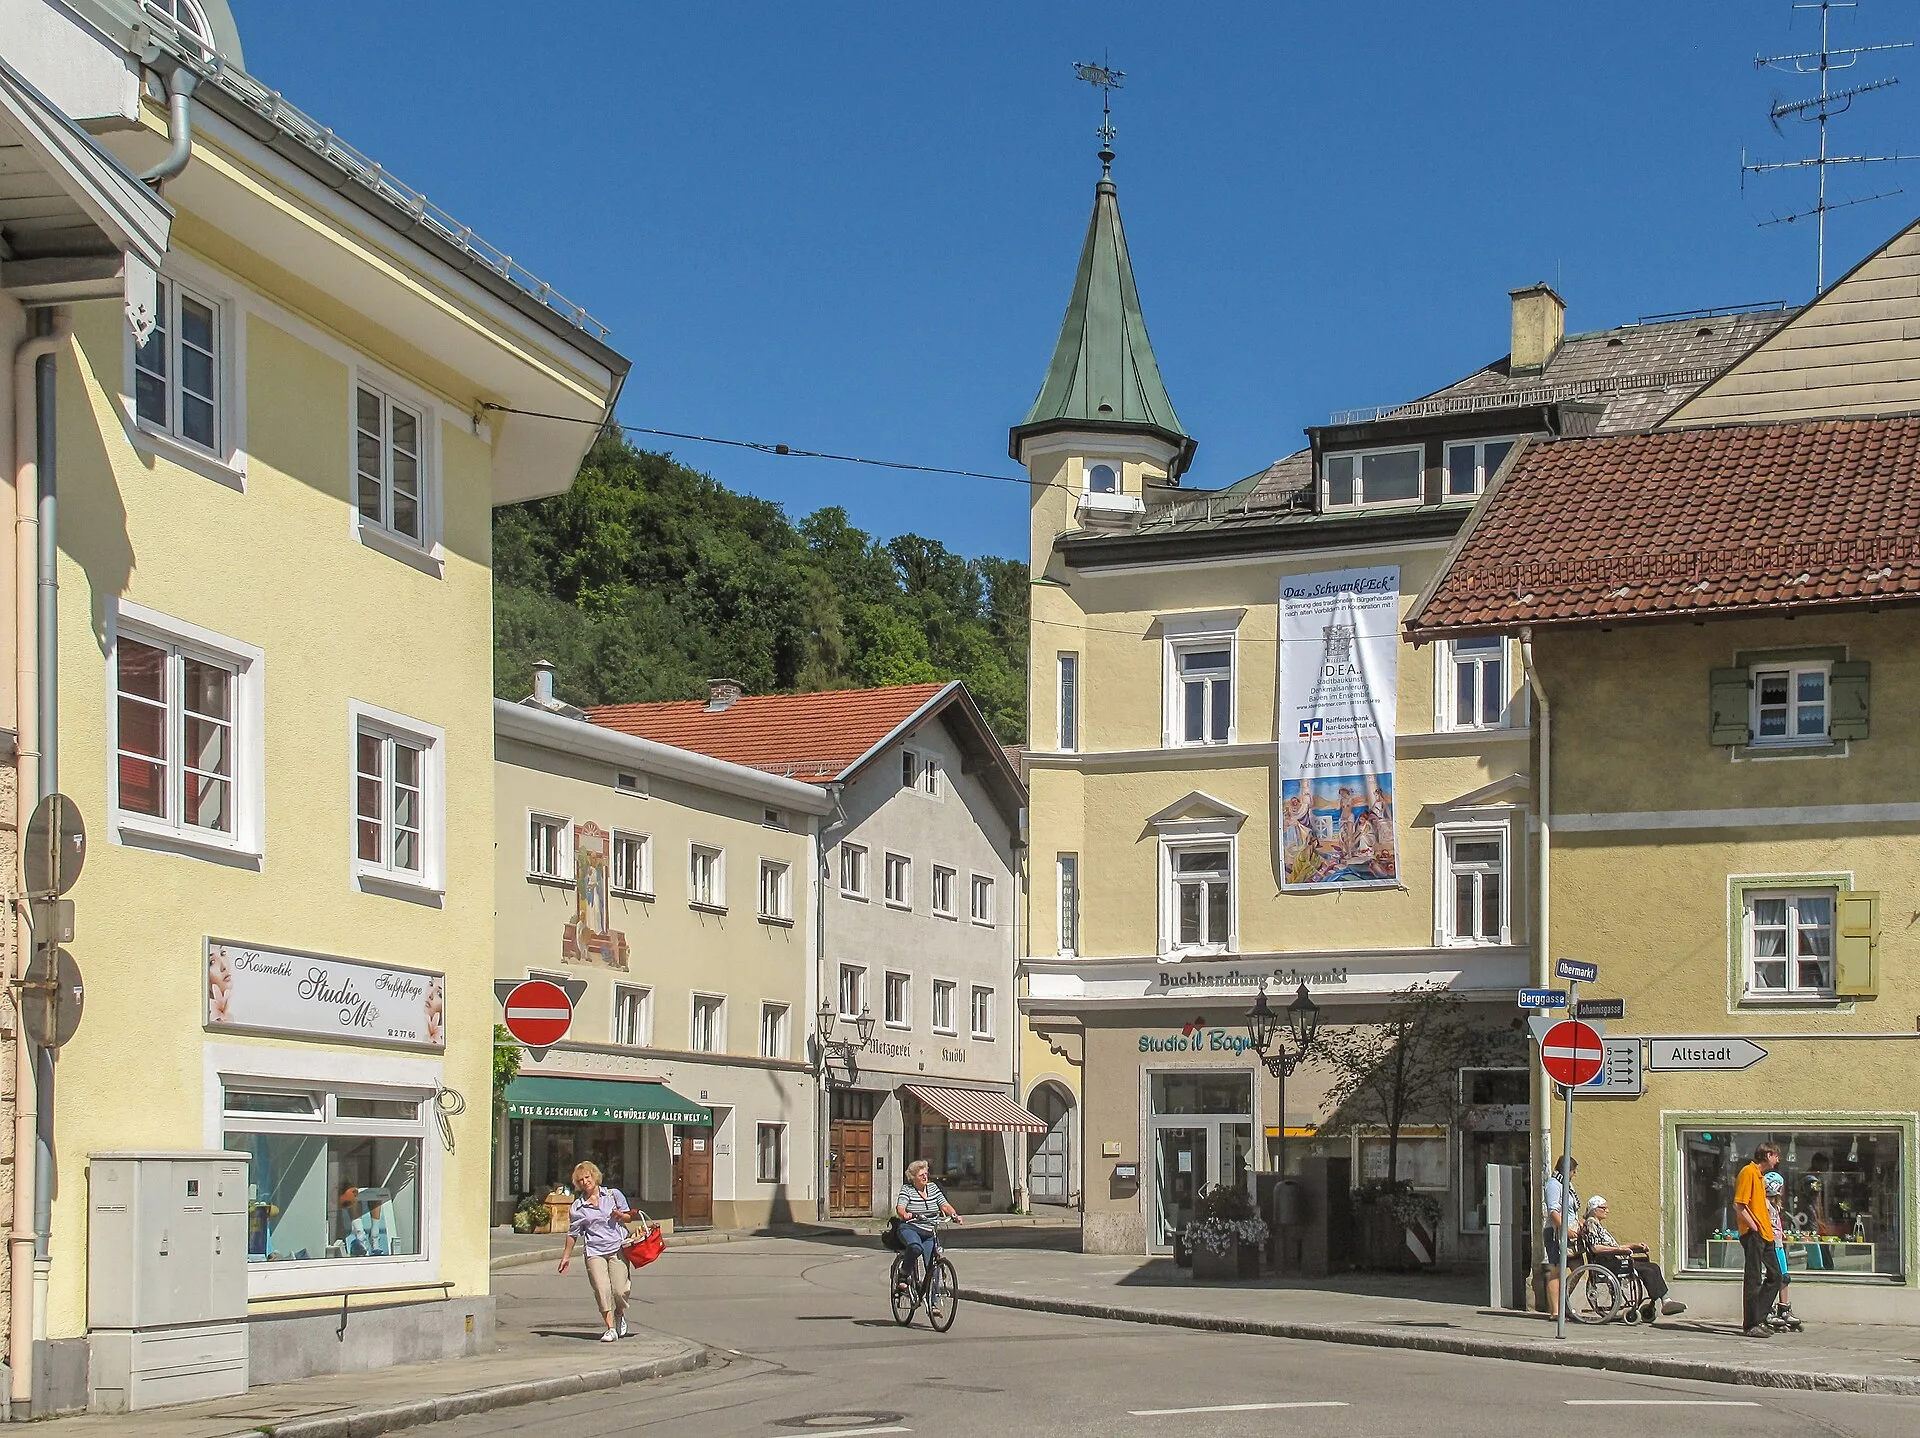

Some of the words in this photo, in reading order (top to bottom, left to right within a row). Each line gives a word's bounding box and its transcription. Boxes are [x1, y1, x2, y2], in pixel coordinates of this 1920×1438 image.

[1283, 587, 1305, 598] Das
[1285, 602, 1311, 611] Sanierung
[1357, 595, 1393, 603] Bürgerhauses
[1325, 714, 1369, 724] Raiffeisenbank
[1314, 752, 1328, 760] Zink
[1335, 751, 1360, 759] Partner
[1299, 762, 1331, 770] Architekten
[1344, 759, 1375, 768] Ingenieure
[234, 951, 293, 977] Kosmetik
[1559, 962, 1595, 979] Obermarkt
[1159, 971, 1268, 990] Buchhandlung
[1273, 967, 1347, 987] Schwankl
[297, 967, 361, 1007] Studio
[374, 973, 423, 1002] Fußpflege
[1521, 992, 1565, 1006] Berggasse
[338, 1000, 372, 1028] M
[1579, 1003, 1621, 1017] Johannisgasse
[868, 1038, 911, 1058] Metzgerei
[1138, 1034, 1188, 1053] Studio
[1191, 1030, 1204, 1052] il
[1207, 1027, 1256, 1057] Bagn
[1606, 1047, 1612, 1056] 5
[1671, 1047, 1731, 1061] Altstadt
[1606, 1057, 1613, 1066] 4
[1606, 1067, 1612, 1076] 3
[1606, 1077, 1613, 1086] 2
[519, 1105, 535, 1115] TEE
[536, 1106, 542, 1116] &
[544, 1106, 589, 1117] GESCHENKE
[613, 1107, 647, 1120] GEWÜRZE
[647, 1111, 660, 1121] AUS
[660, 1111, 682, 1122] ALLER
[682, 1112, 700, 1122] WELT
